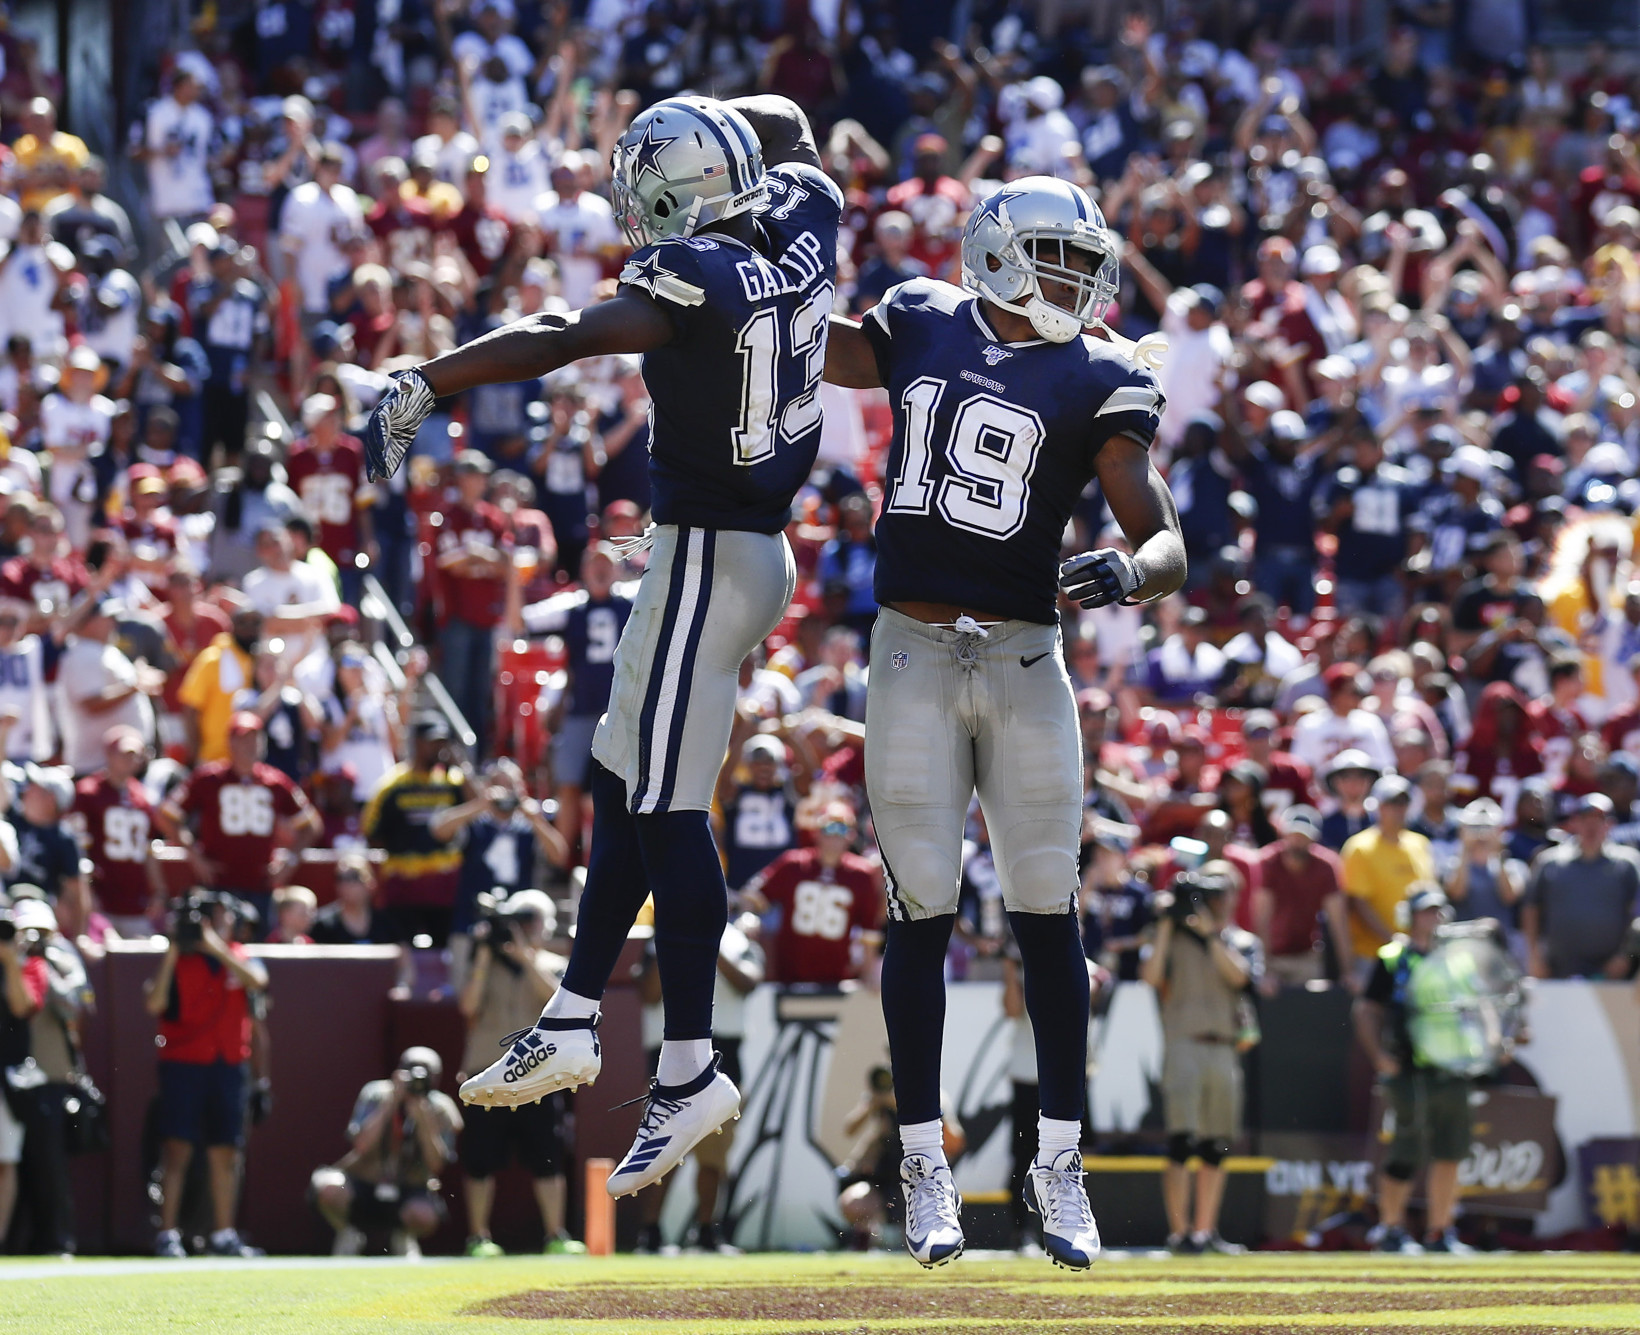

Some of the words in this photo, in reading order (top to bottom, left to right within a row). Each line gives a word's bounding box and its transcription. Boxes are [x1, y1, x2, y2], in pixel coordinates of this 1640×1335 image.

[731, 278, 836, 466] 13
[960, 369, 1006, 394] COWBOYS
[886, 375, 1047, 541] 19
[218, 783, 275, 837] 86
[792, 880, 854, 941] 86
[503, 1042, 558, 1083] adidas
